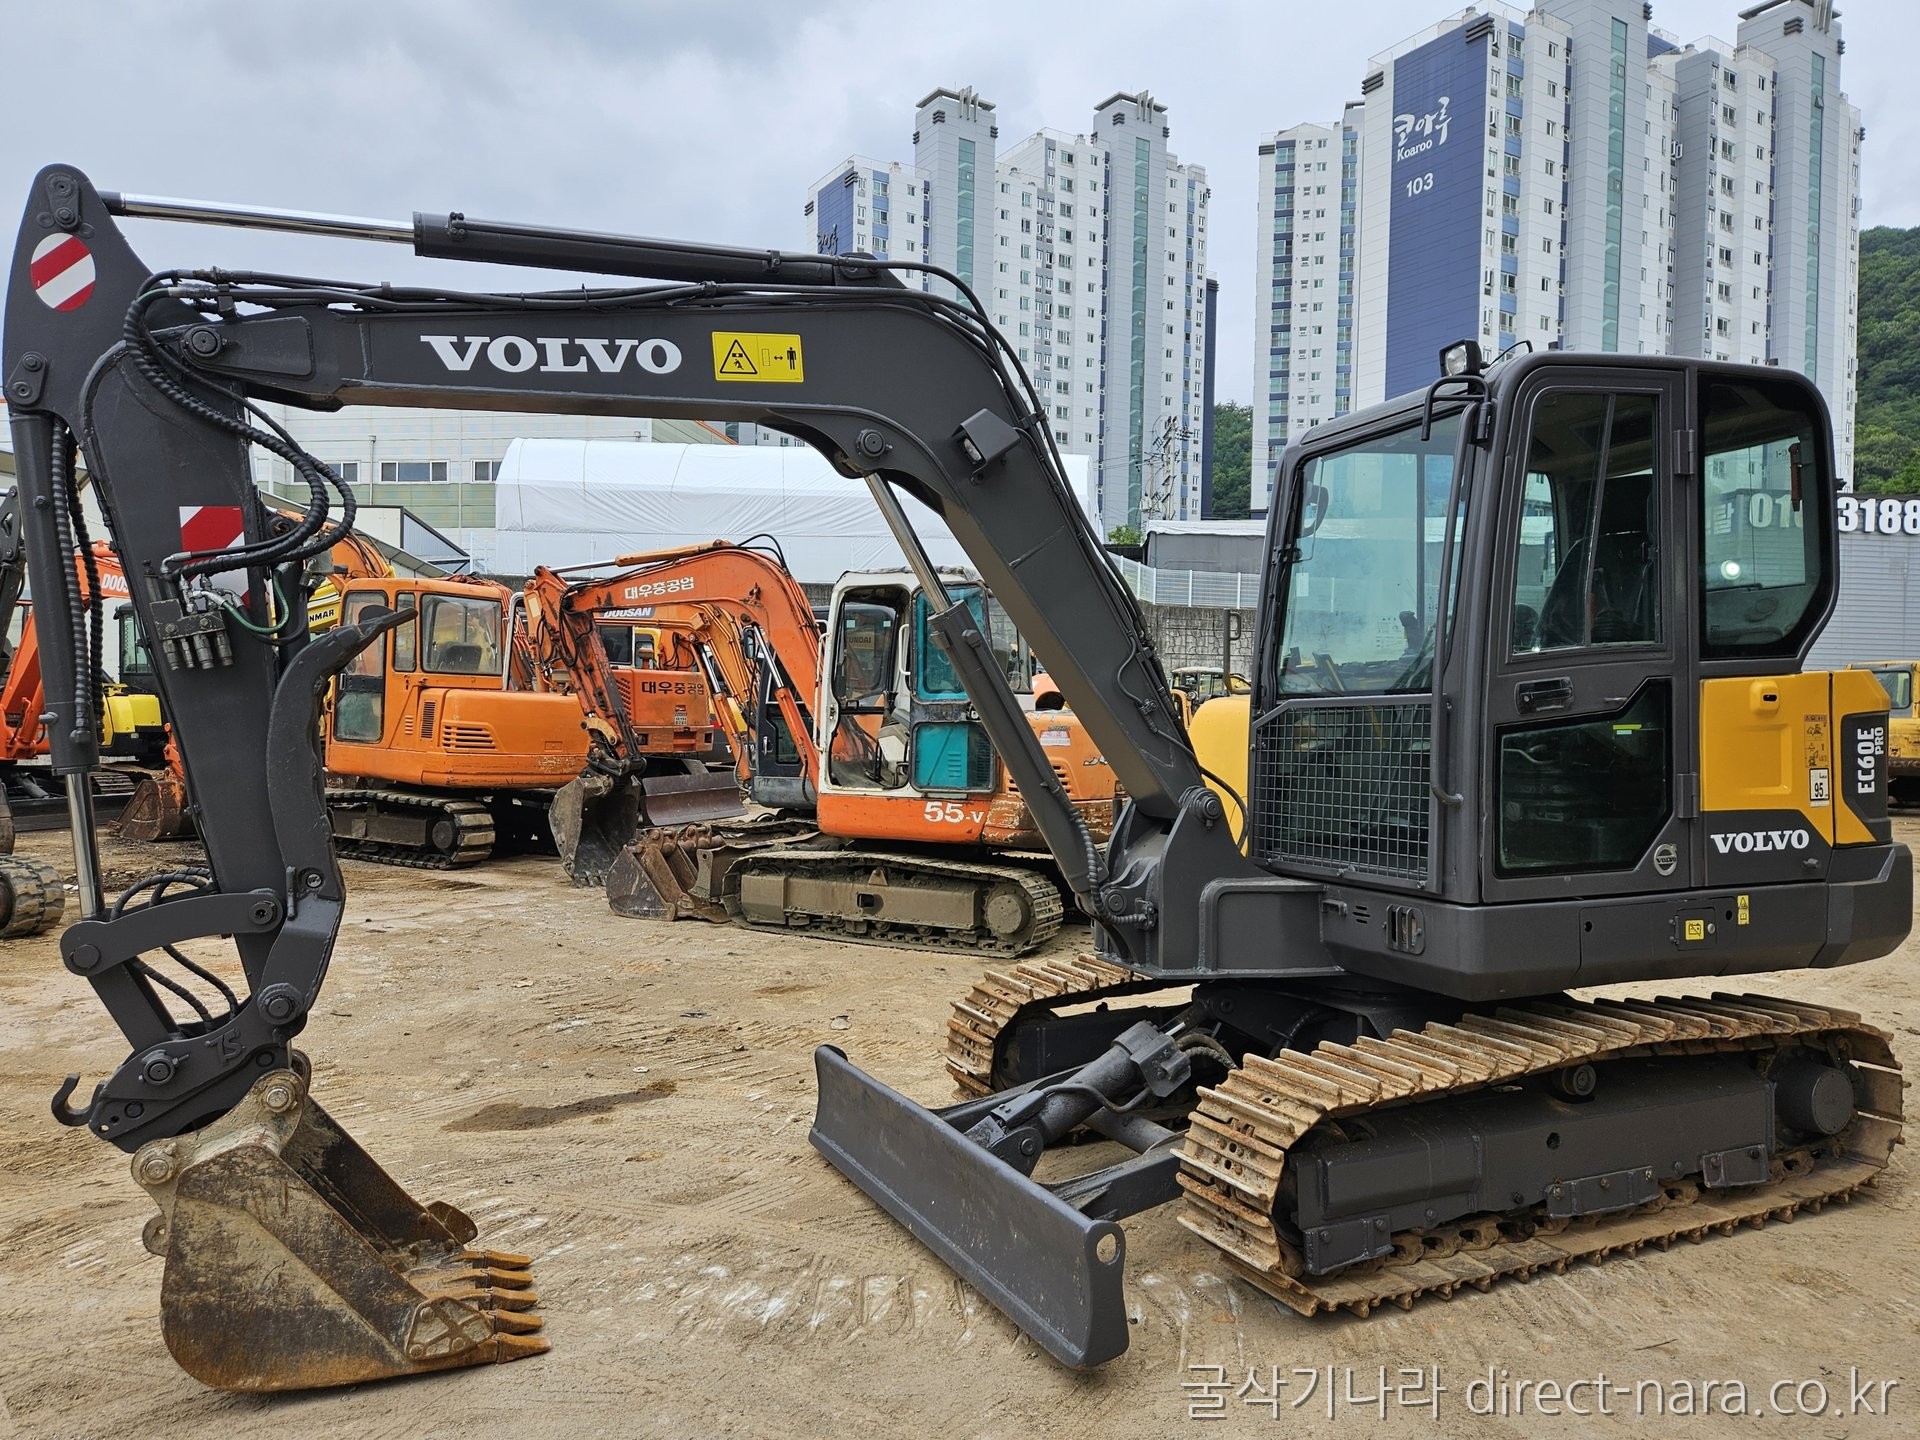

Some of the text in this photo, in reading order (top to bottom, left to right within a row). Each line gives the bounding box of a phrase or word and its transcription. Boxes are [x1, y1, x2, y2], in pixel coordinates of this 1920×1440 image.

[1393, 96, 1452, 147] 코아루
[1396, 139, 1433, 162] Koaroo
[1406, 172, 1434, 197] 103
[420, 335, 682, 373] VOLVO
[1750, 493, 1803, 528] 01
[624, 576, 695, 600] 대우중공업
[641, 681, 704, 695] 대우중공업
[1874, 727, 1884, 755] PRO
[1857, 728, 1875, 794] EC60E
[1814, 782, 1824, 797] 95
[1710, 829, 1810, 854] VOLVO
[1655, 855, 1677, 865] VOLVO
